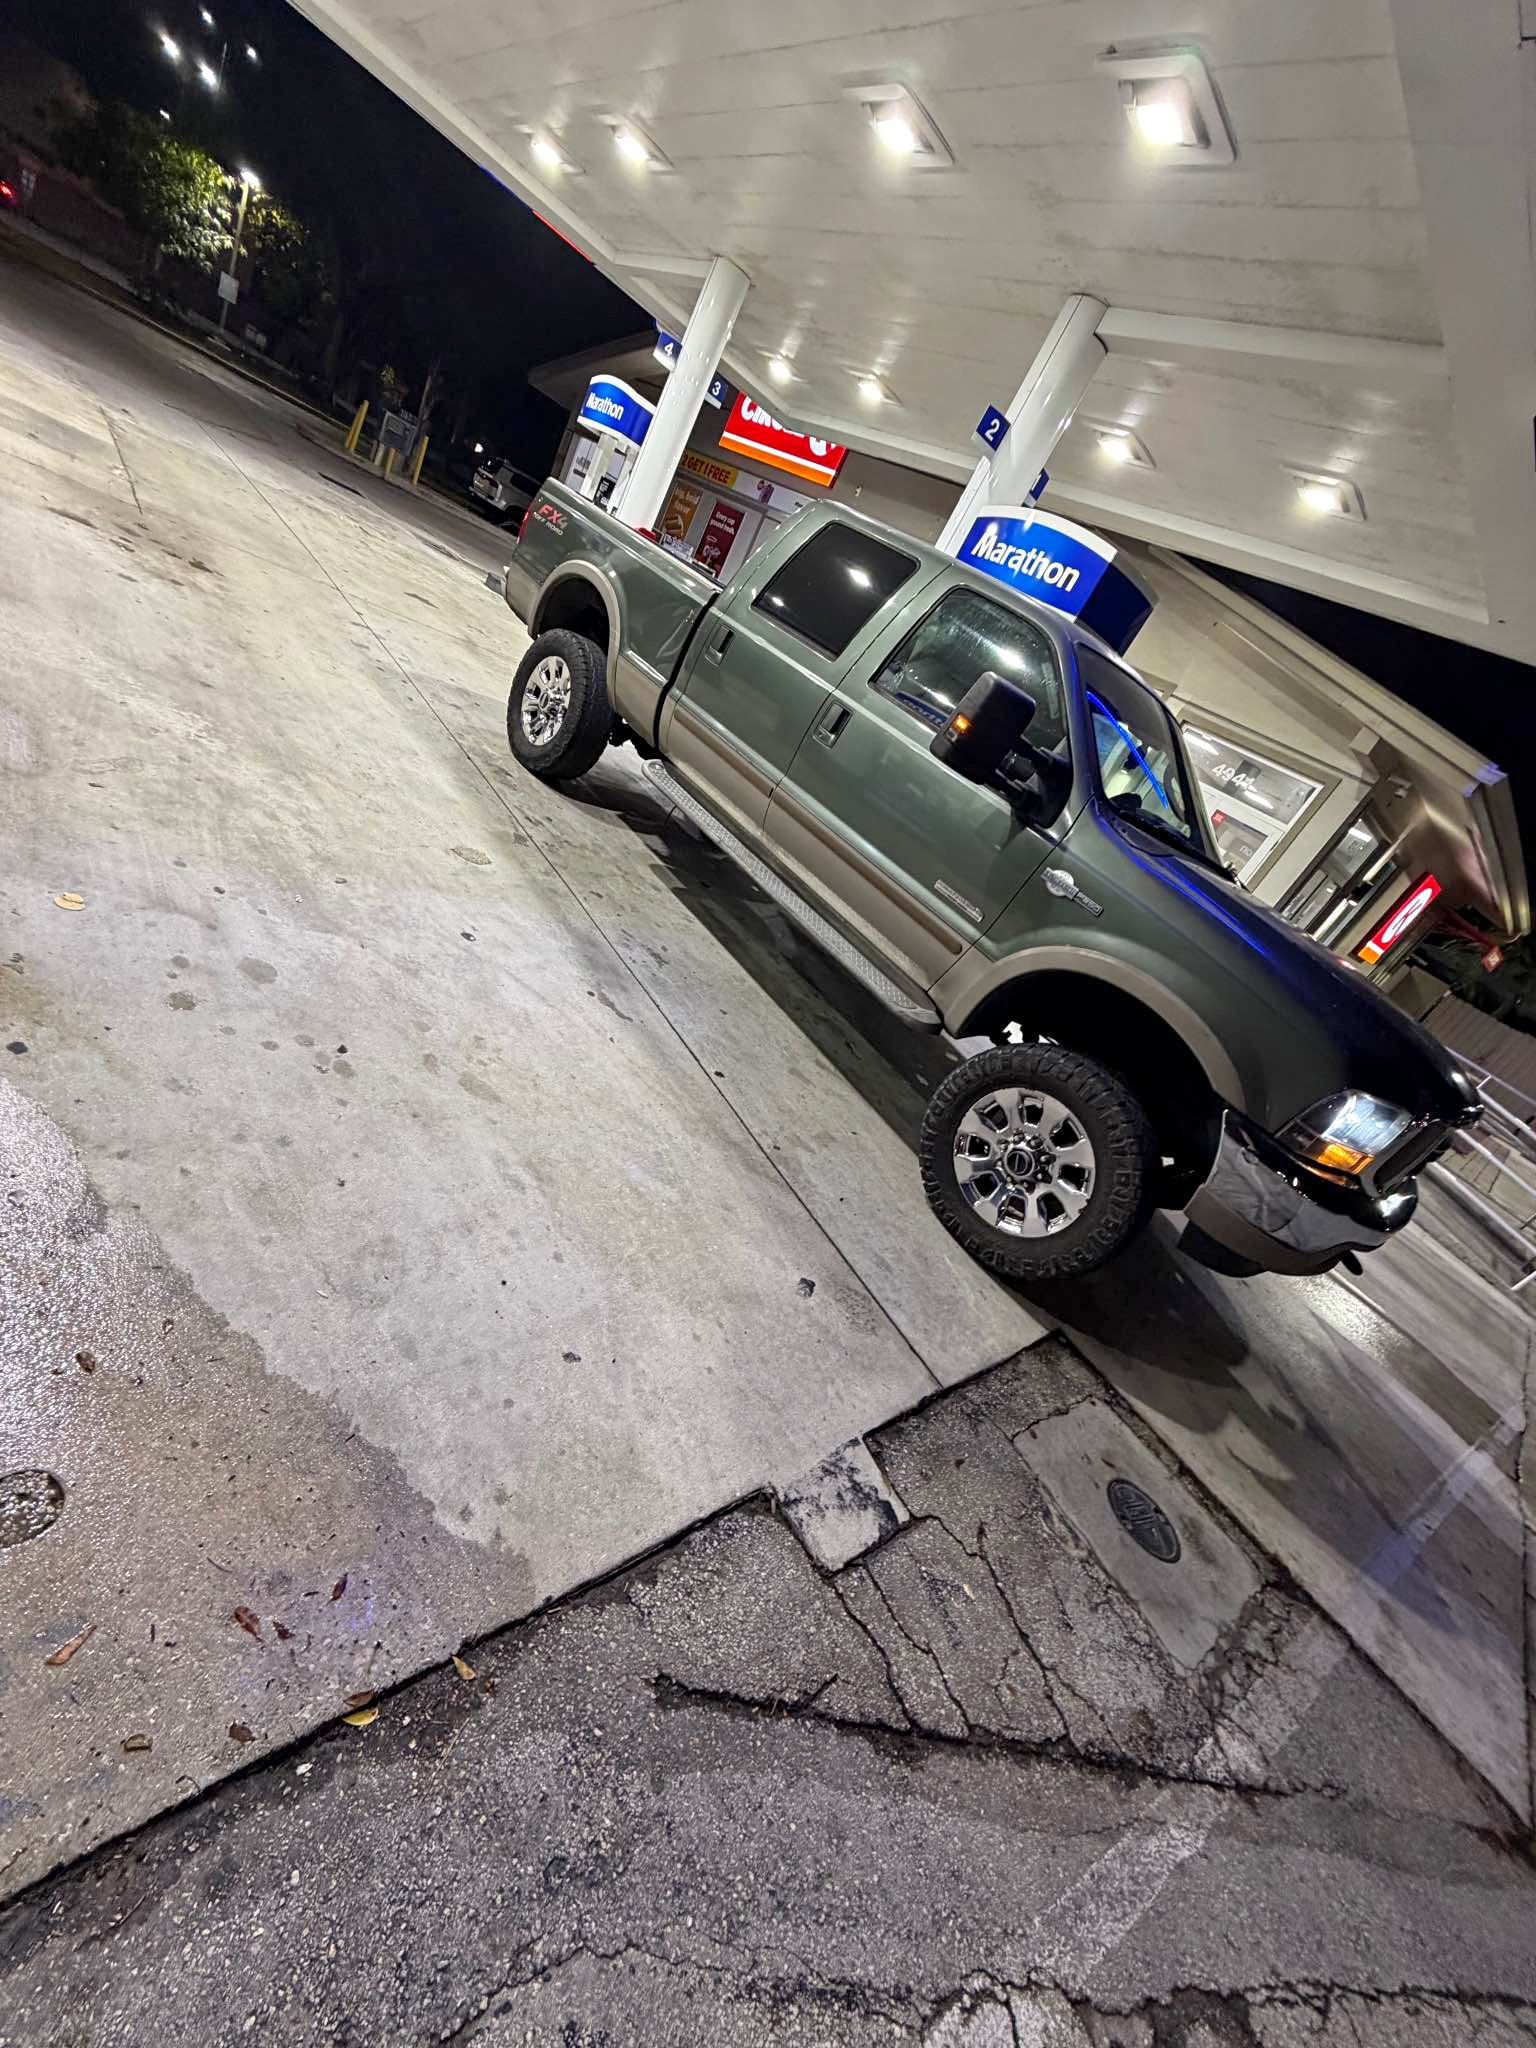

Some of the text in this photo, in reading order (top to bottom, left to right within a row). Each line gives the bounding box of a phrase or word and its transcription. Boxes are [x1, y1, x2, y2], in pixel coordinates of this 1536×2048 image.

[664, 342, 674, 357] 4
[712, 381, 721, 396] 3
[586, 392, 624, 421] Marathon
[985, 418, 1000, 442] 2
[688, 456, 706, 473] GET
[708, 464, 731, 484] FREE
[538, 504, 569, 530] FX4
[971, 532, 1080, 592] Marathon
